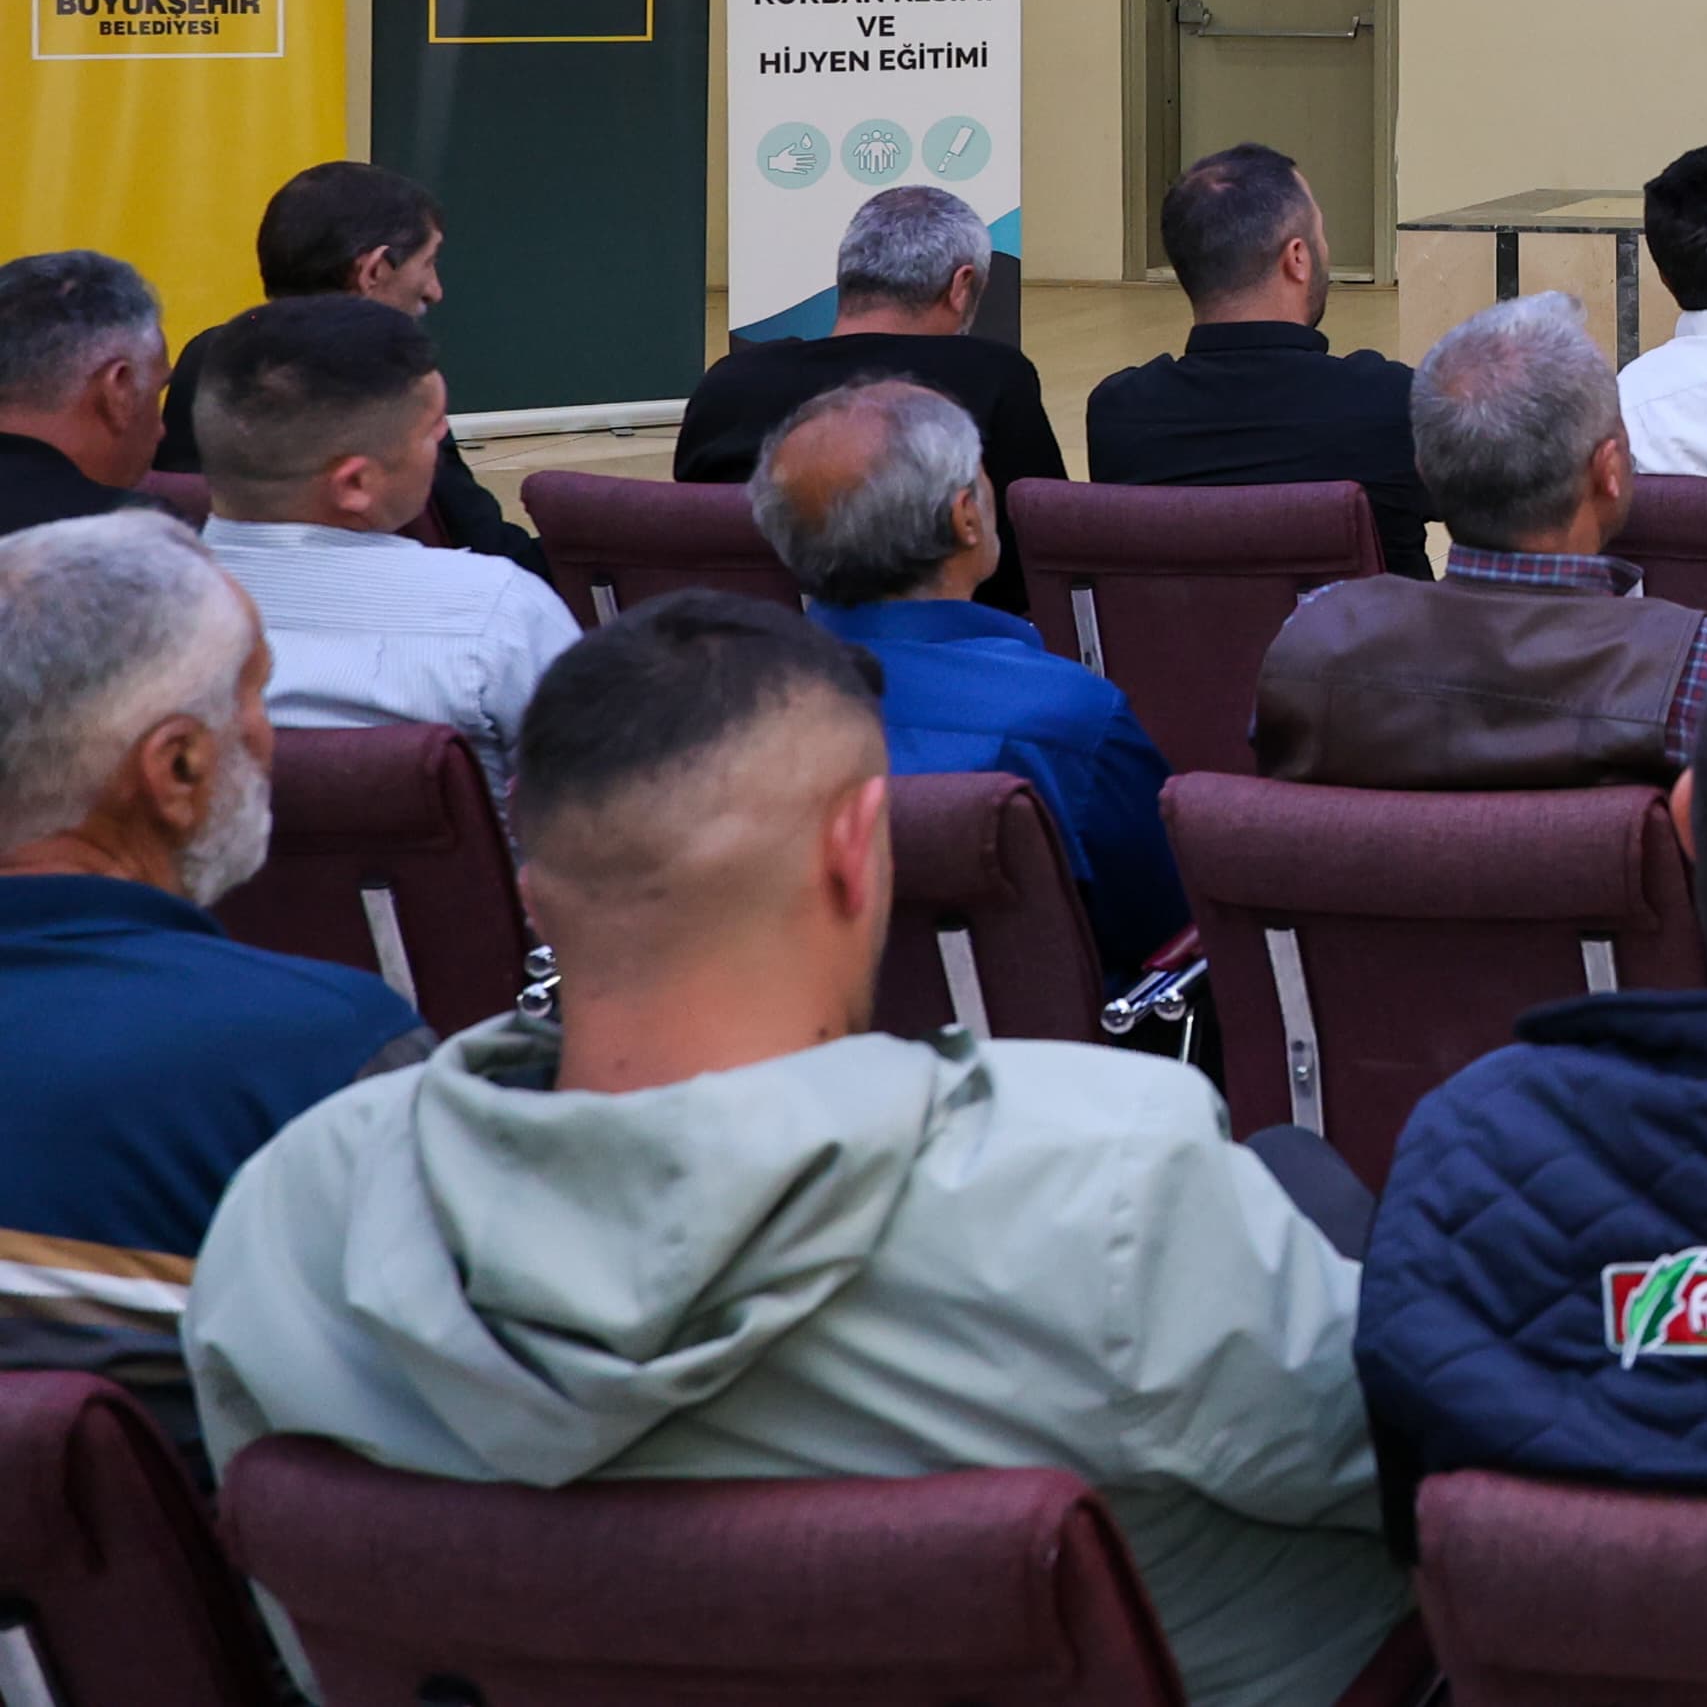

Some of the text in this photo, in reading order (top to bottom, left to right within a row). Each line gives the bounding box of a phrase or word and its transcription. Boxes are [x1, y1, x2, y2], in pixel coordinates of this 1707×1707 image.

[99, 16, 220, 36] BELEDİYESİ
[856, 15, 896, 38] VE
[759, 41, 988, 75] HİJYEN EĞİTİMİ
